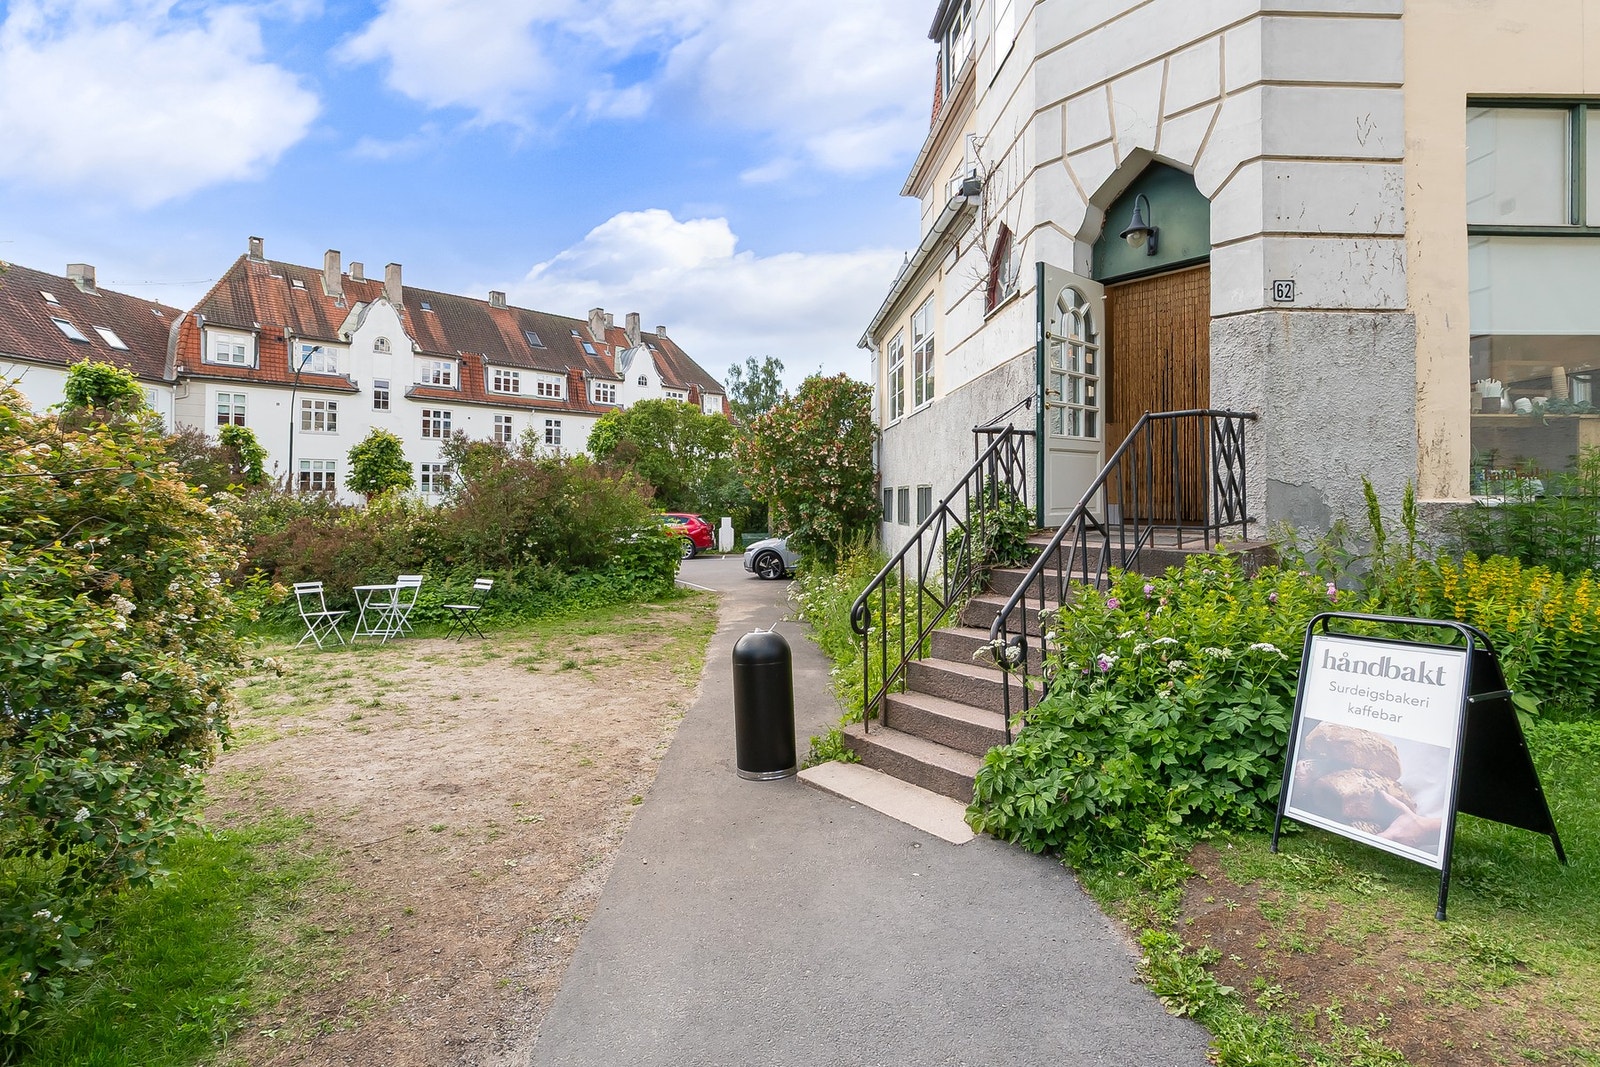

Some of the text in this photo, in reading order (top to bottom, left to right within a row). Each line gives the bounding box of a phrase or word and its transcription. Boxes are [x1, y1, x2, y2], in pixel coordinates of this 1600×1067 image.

[1276, 283, 1292, 299] 62
[1321, 649, 1447, 687] håndbakt
[1328, 680, 1430, 708] Surdeigsbakeri
[1347, 702, 1403, 723] kaffebar
